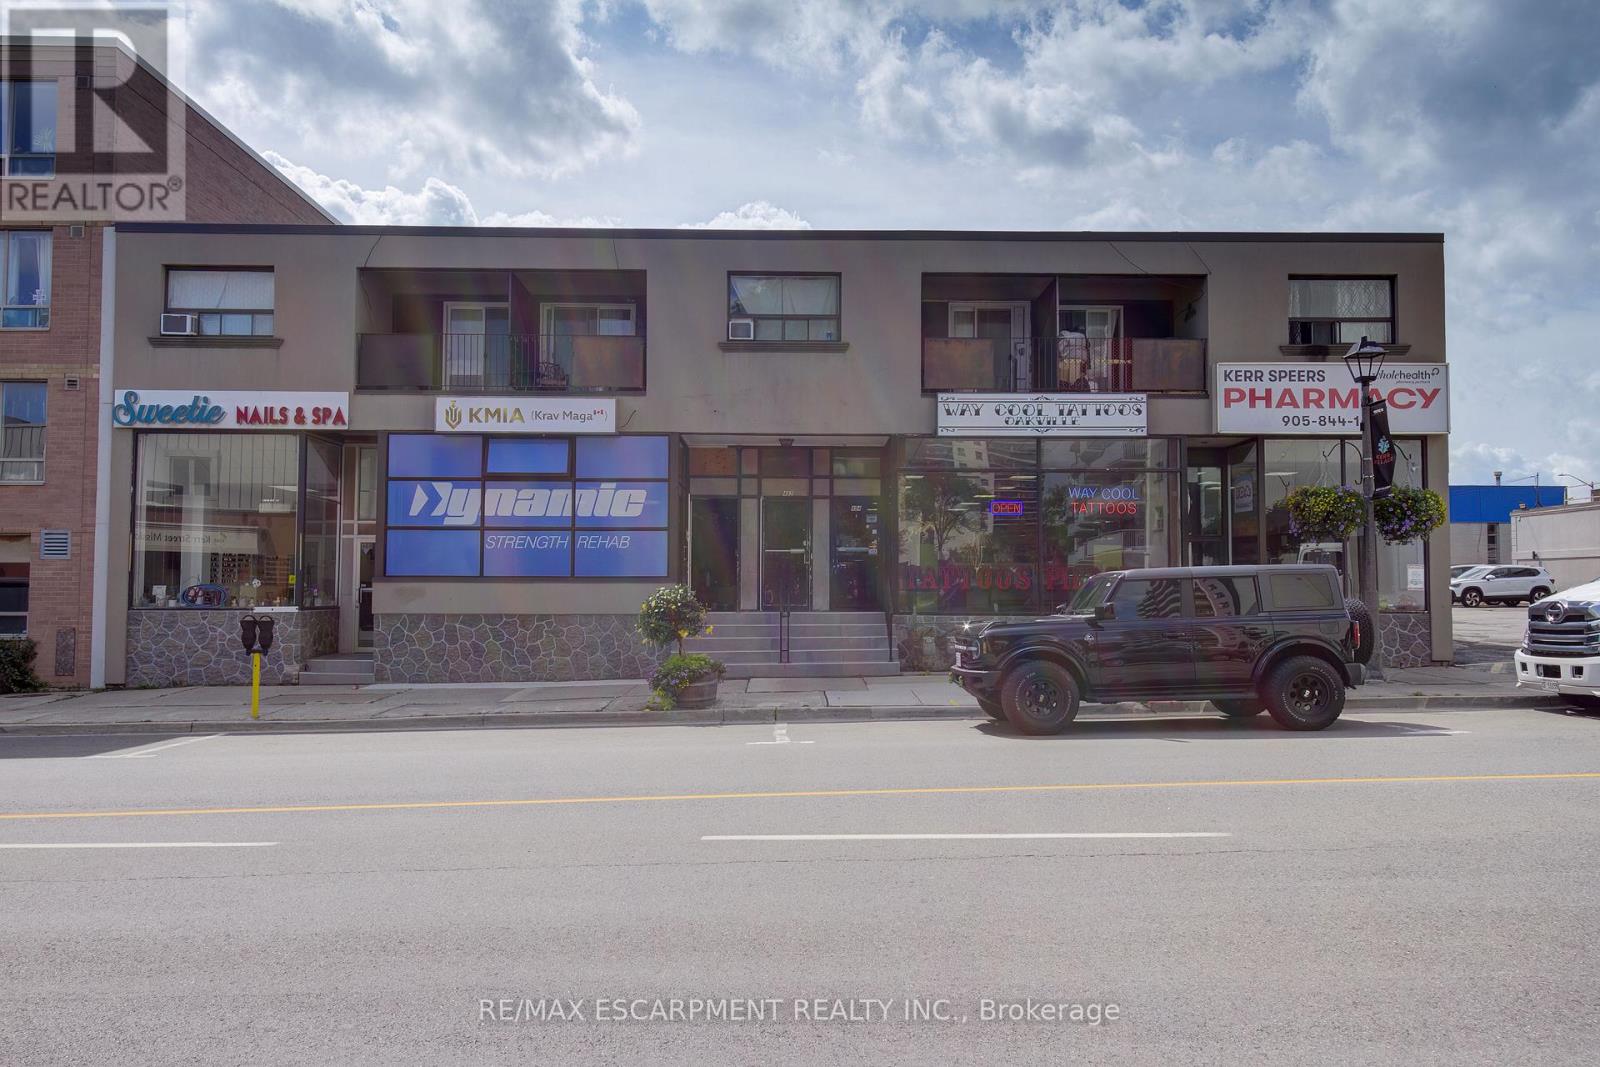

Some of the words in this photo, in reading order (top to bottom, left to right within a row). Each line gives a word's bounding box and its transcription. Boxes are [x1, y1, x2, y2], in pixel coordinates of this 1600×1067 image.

[1224, 370, 1263, 382] KERR
[1268, 370, 1326, 382] SPEERS
[112, 390, 226, 427] Sweetie
[236, 405, 289, 425] NAILS
[294, 406, 306, 425] &
[312, 406, 347, 425] SPA
[942, 403, 984, 416] WAY
[995, 403, 1049, 416] COOL
[1055, 403, 1143, 416] TATTOOS
[469, 407, 526, 423] KMIA
[1004, 416, 1080, 426] OAKVILLE
[1282, 415, 1360, 427] 905-844-1
[1068, 487, 1098, 499] WAY
[1102, 487, 1139, 500] COOL
[991, 503, 1022, 513] OPEN
[1071, 502, 1137, 514] TATTOOS
[485, 535, 569, 549] STRENGTH
[577, 536, 631, 549] REHAB
